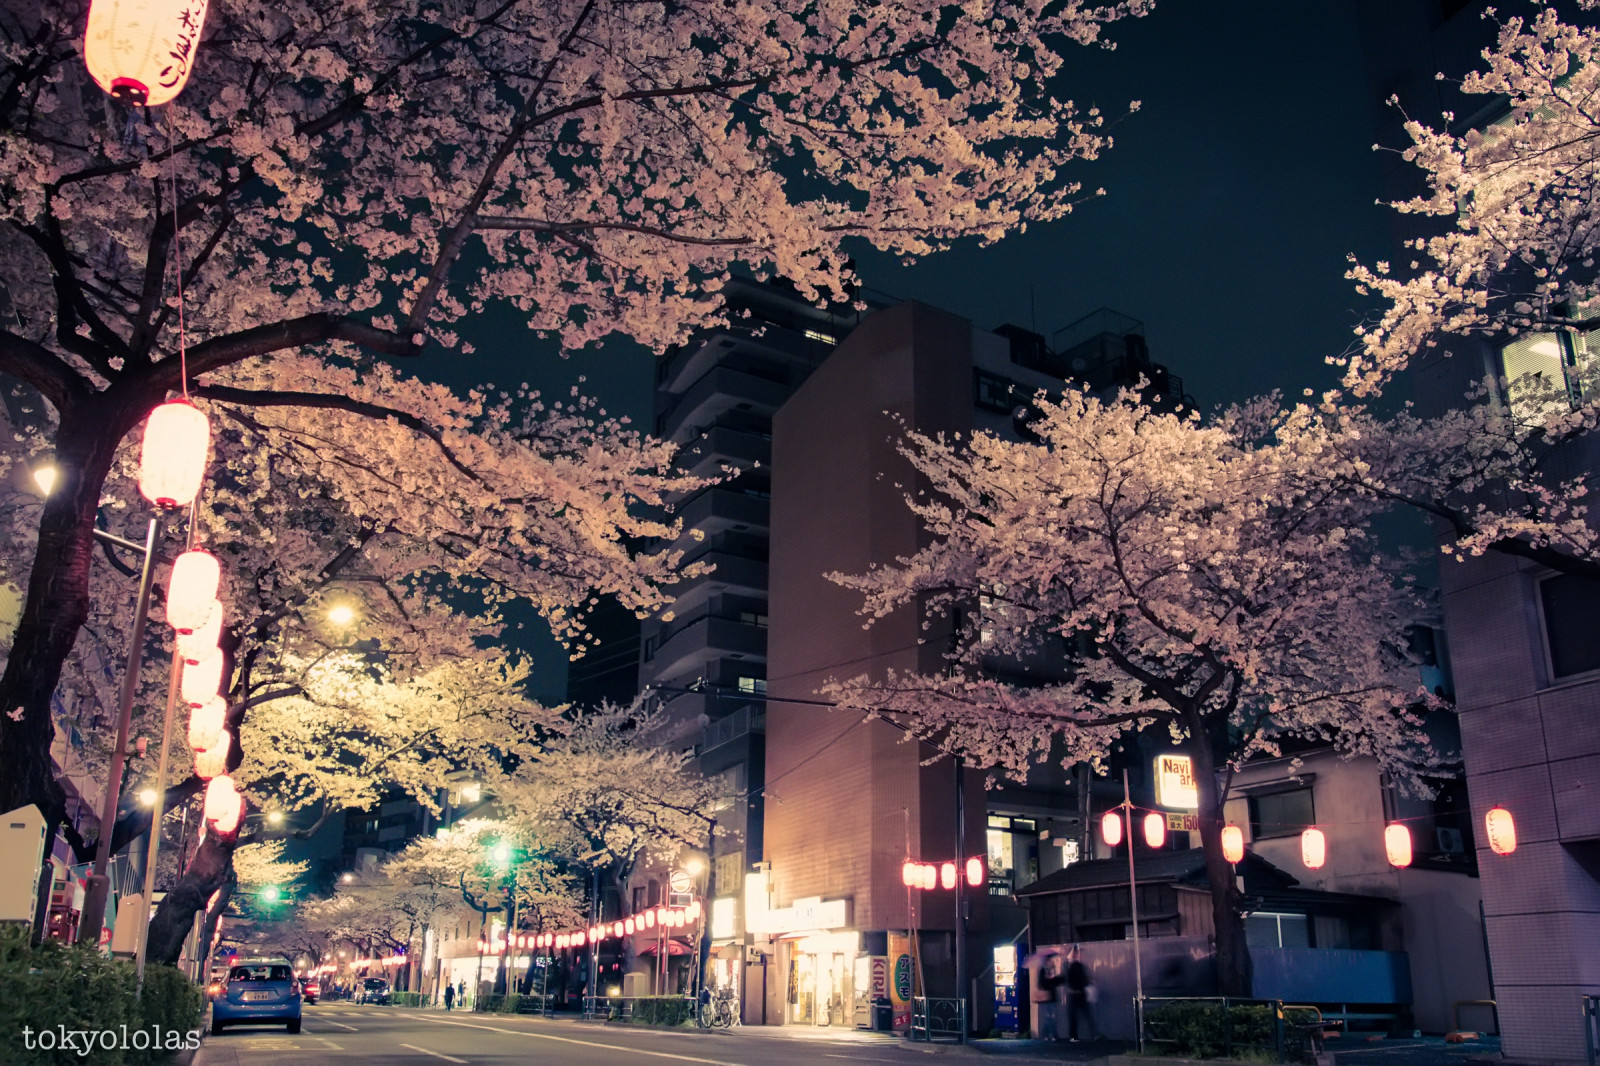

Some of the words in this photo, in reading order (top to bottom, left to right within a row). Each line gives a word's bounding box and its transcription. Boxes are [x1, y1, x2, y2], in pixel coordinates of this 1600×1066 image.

[1163, 758, 1188, 774] Navi
[899, 957, 910, 997] アスモ
[894, 1015, 908, 1026] 2F
